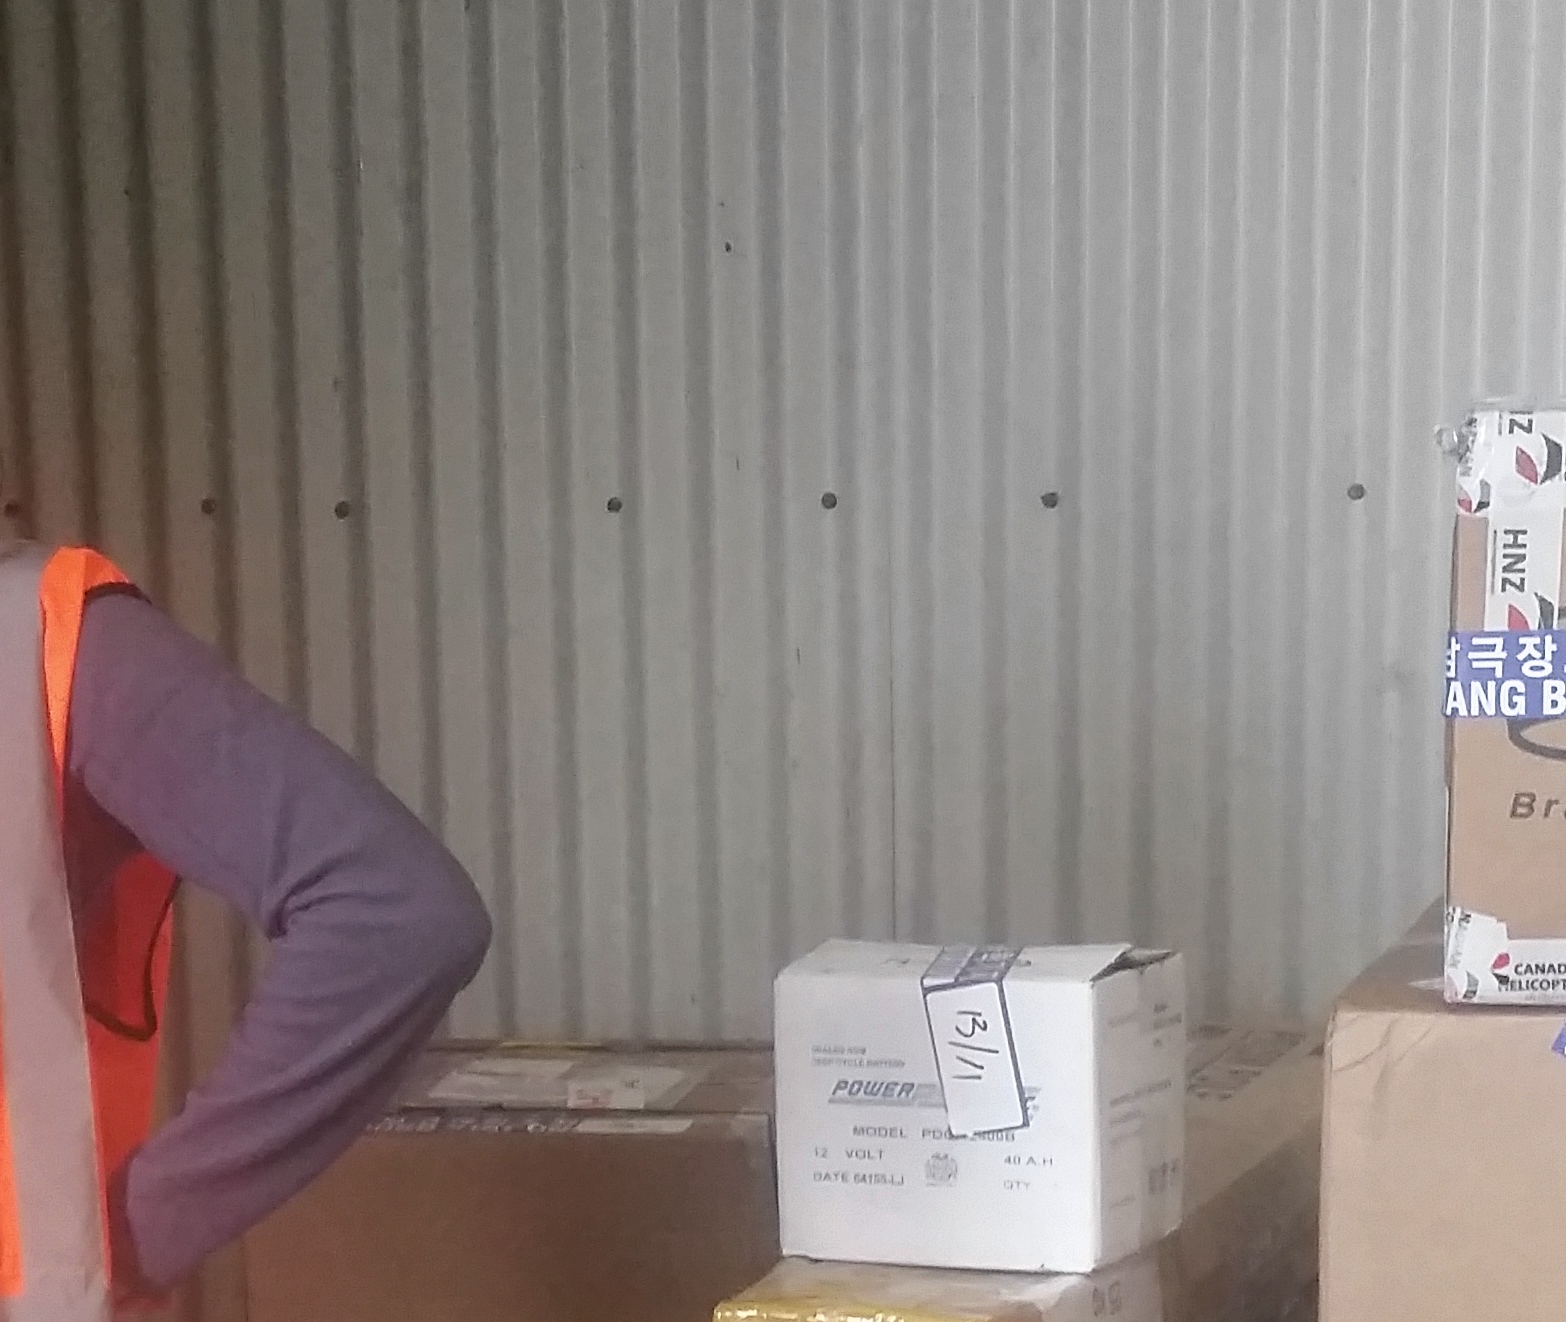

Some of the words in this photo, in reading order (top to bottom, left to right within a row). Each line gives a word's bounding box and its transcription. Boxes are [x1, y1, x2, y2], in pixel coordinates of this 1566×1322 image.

[1501, 528, 1529, 593] HNZ
[1446, 679, 1526, 717] ANG
[947, 1010, 1000, 1081] 13/11
[832, 1080, 915, 1097] POWER
[852, 1125, 907, 1139] MODEL
[845, 1148, 884, 1161] VOLT
[813, 1172, 849, 1184] DATE
